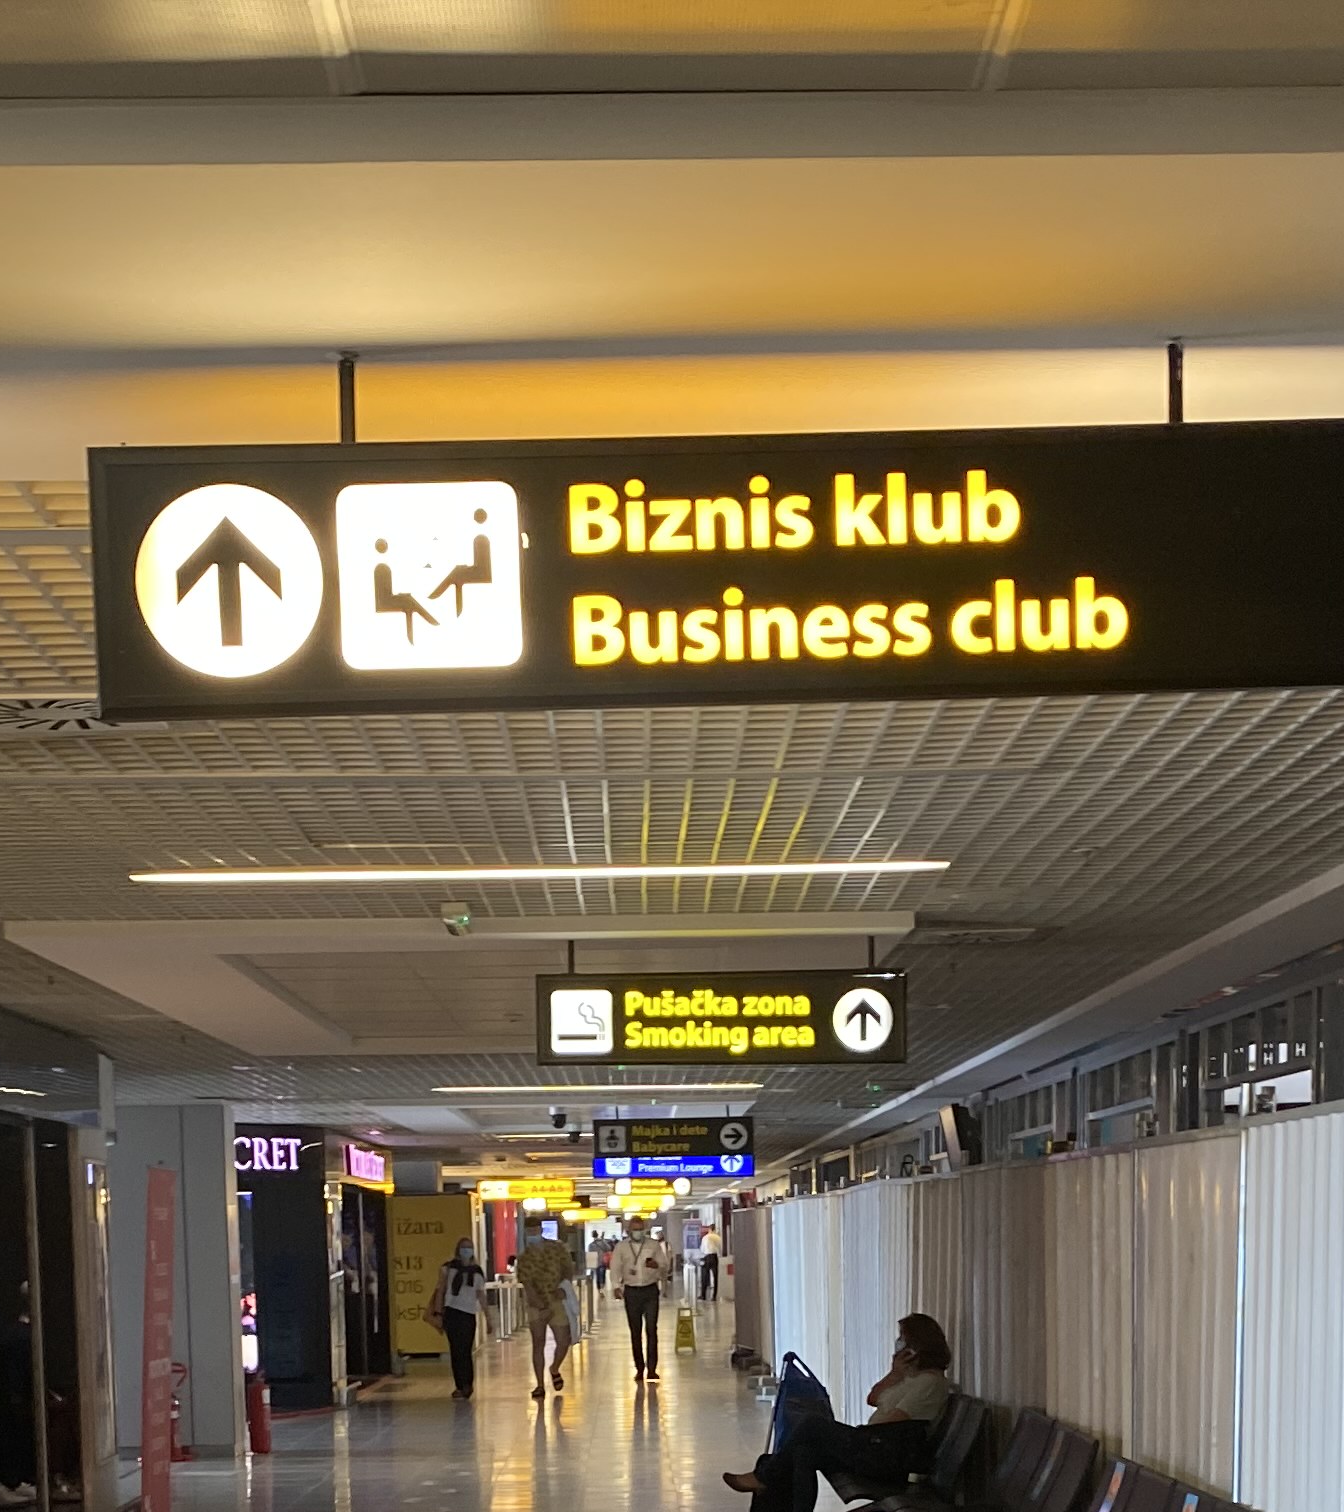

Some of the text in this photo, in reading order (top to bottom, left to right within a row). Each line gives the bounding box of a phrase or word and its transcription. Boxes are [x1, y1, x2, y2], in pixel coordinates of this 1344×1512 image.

[568, 469, 1021, 555] Biznis klub
[572, 576, 1129, 666] Business club
[624, 989, 812, 1017] Pušačka zona
[624, 1020, 816, 1054] Smoking area
[637, 1162, 714, 1175] Premium Lounge
